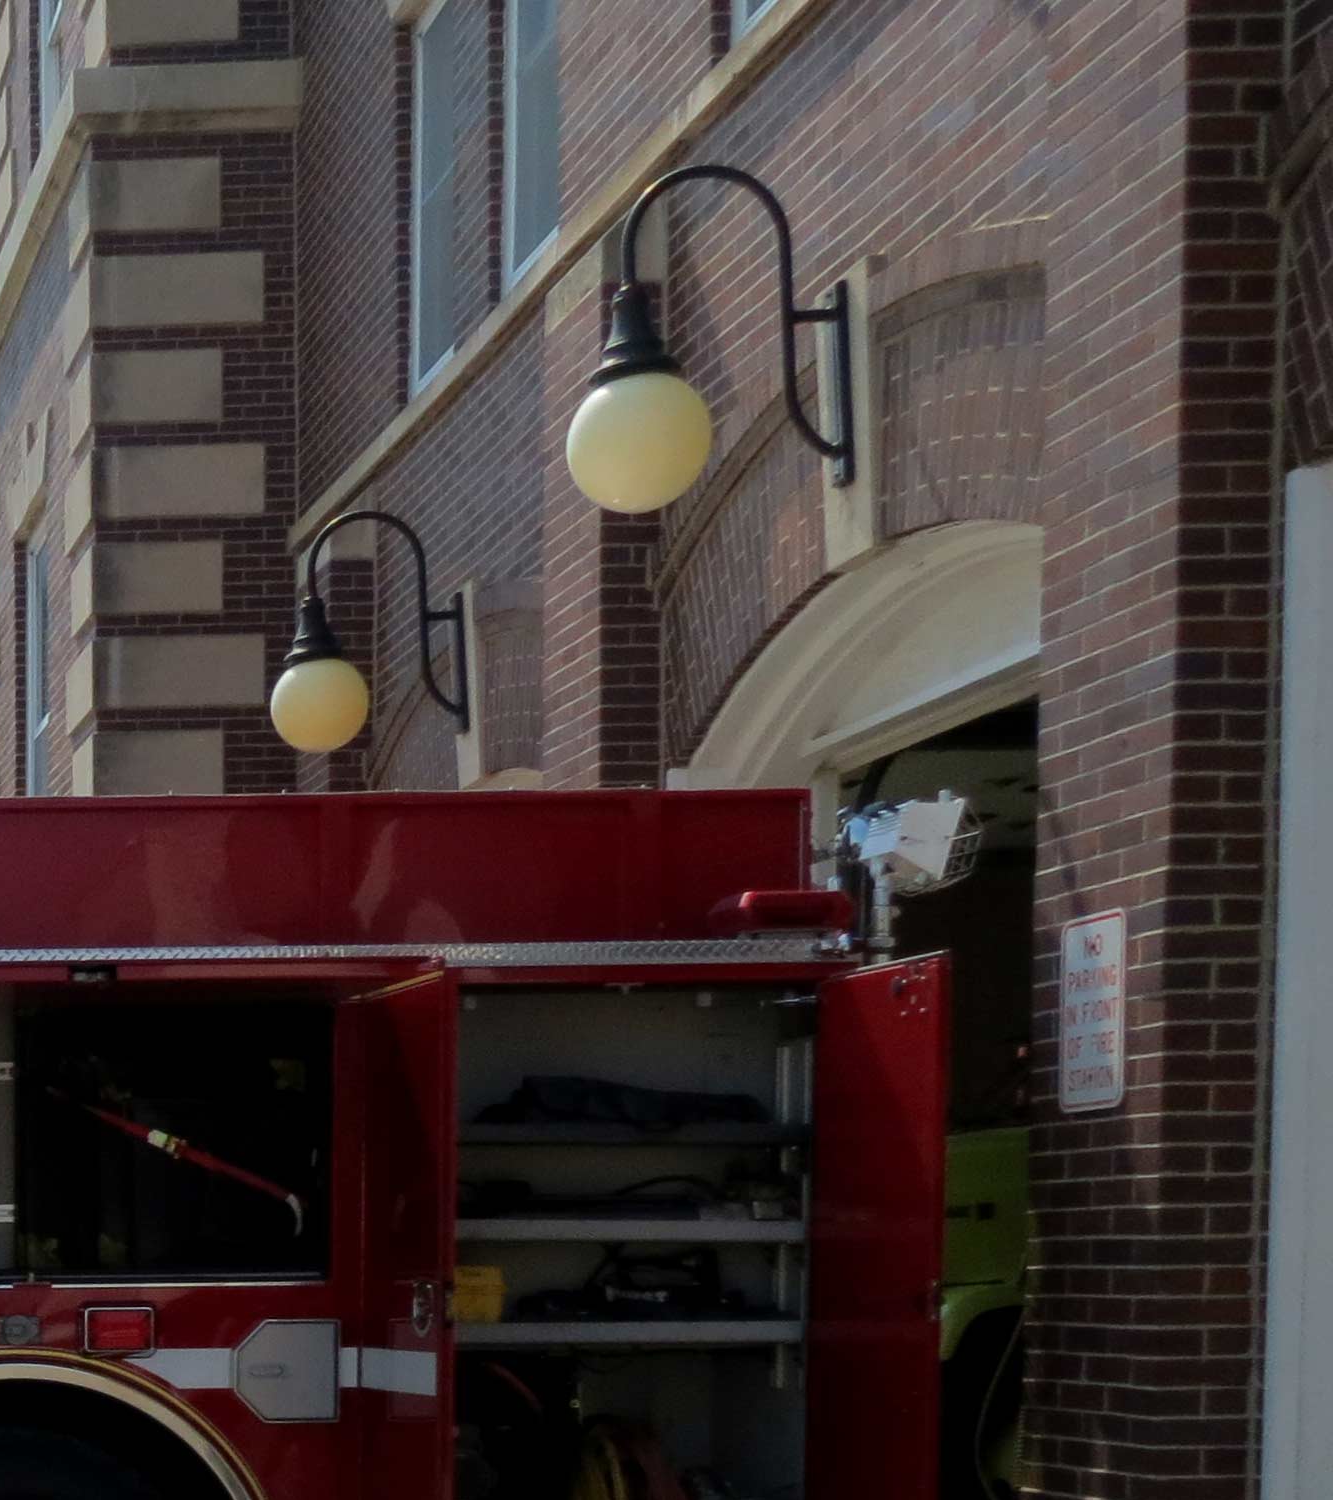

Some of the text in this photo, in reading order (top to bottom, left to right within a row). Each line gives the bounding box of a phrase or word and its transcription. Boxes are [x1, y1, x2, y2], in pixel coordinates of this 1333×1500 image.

[1083, 933, 1103, 959] NO
[1066, 964, 1118, 994] PARKING
[1066, 997, 1120, 1027] IN FRONT
[1067, 1030, 1115, 1060] OF FIRE
[1067, 1066, 1114, 1092] STATION
